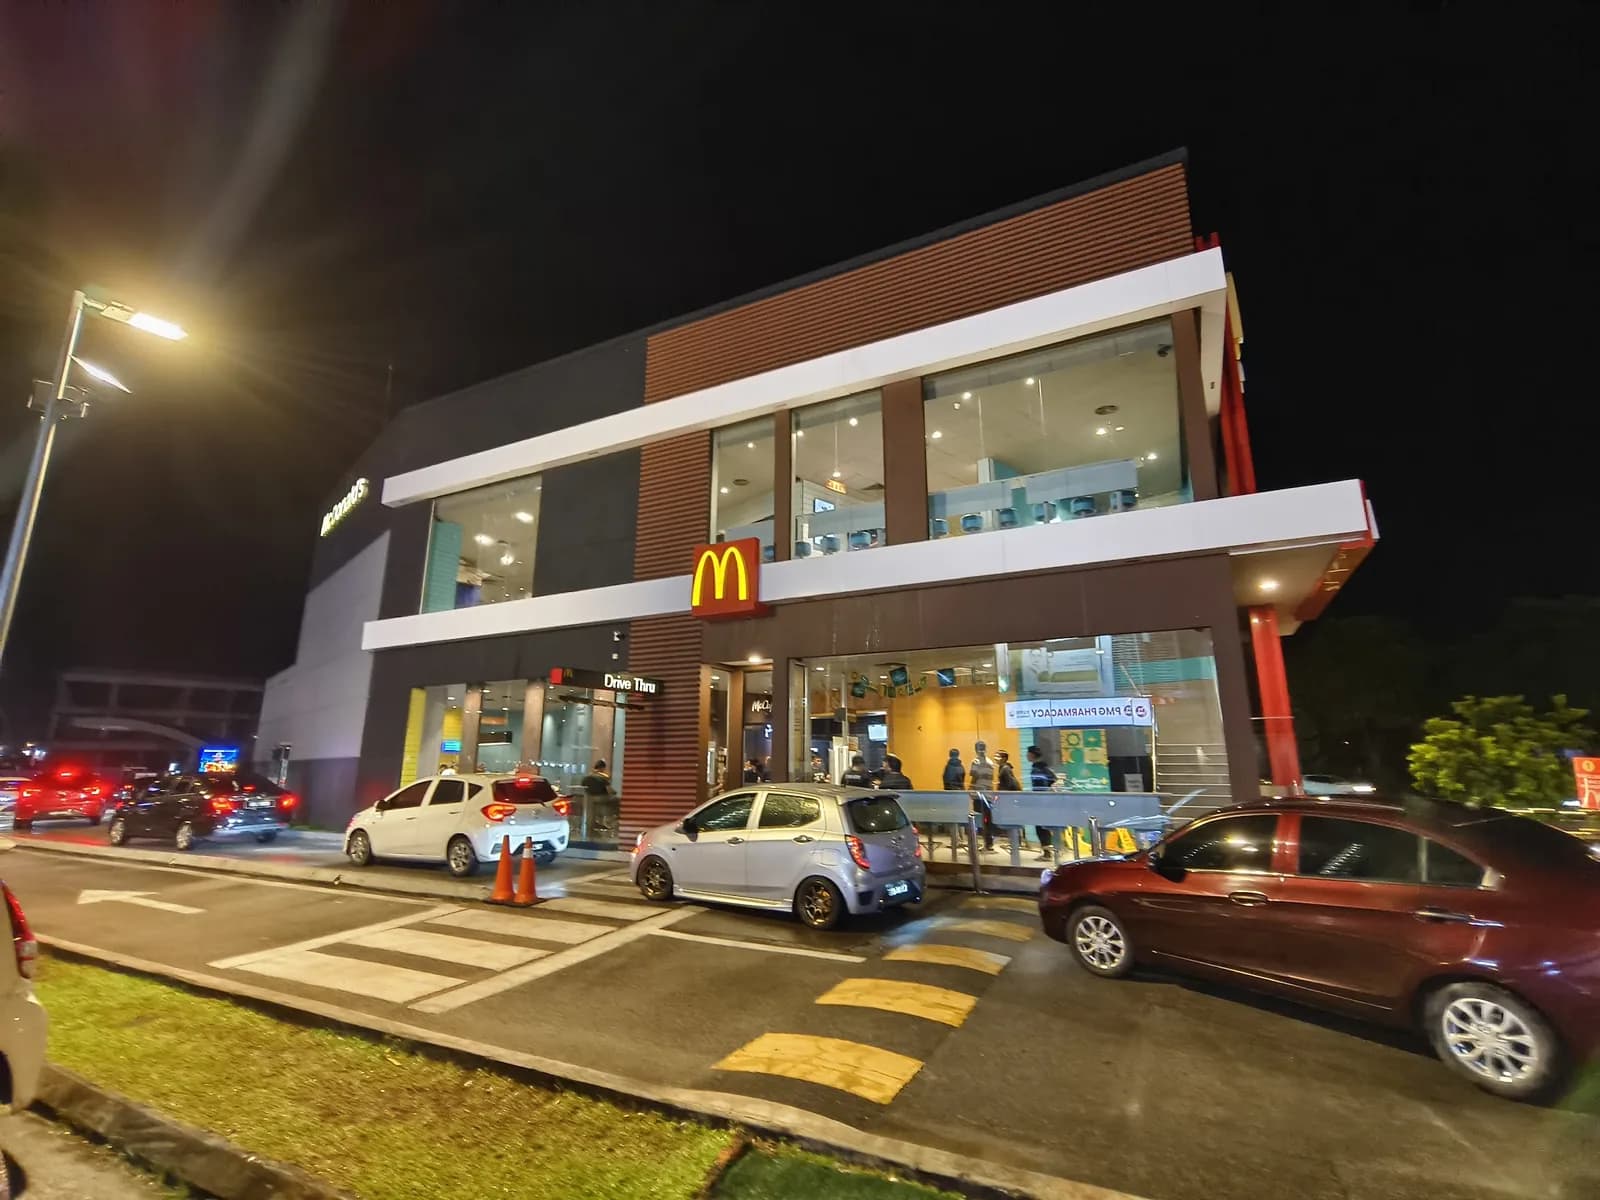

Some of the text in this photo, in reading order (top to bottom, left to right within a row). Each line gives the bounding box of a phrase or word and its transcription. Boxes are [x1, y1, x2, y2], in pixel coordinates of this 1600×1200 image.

[692, 546, 747, 606] M
[604, 673, 656, 693] Drive Thru
